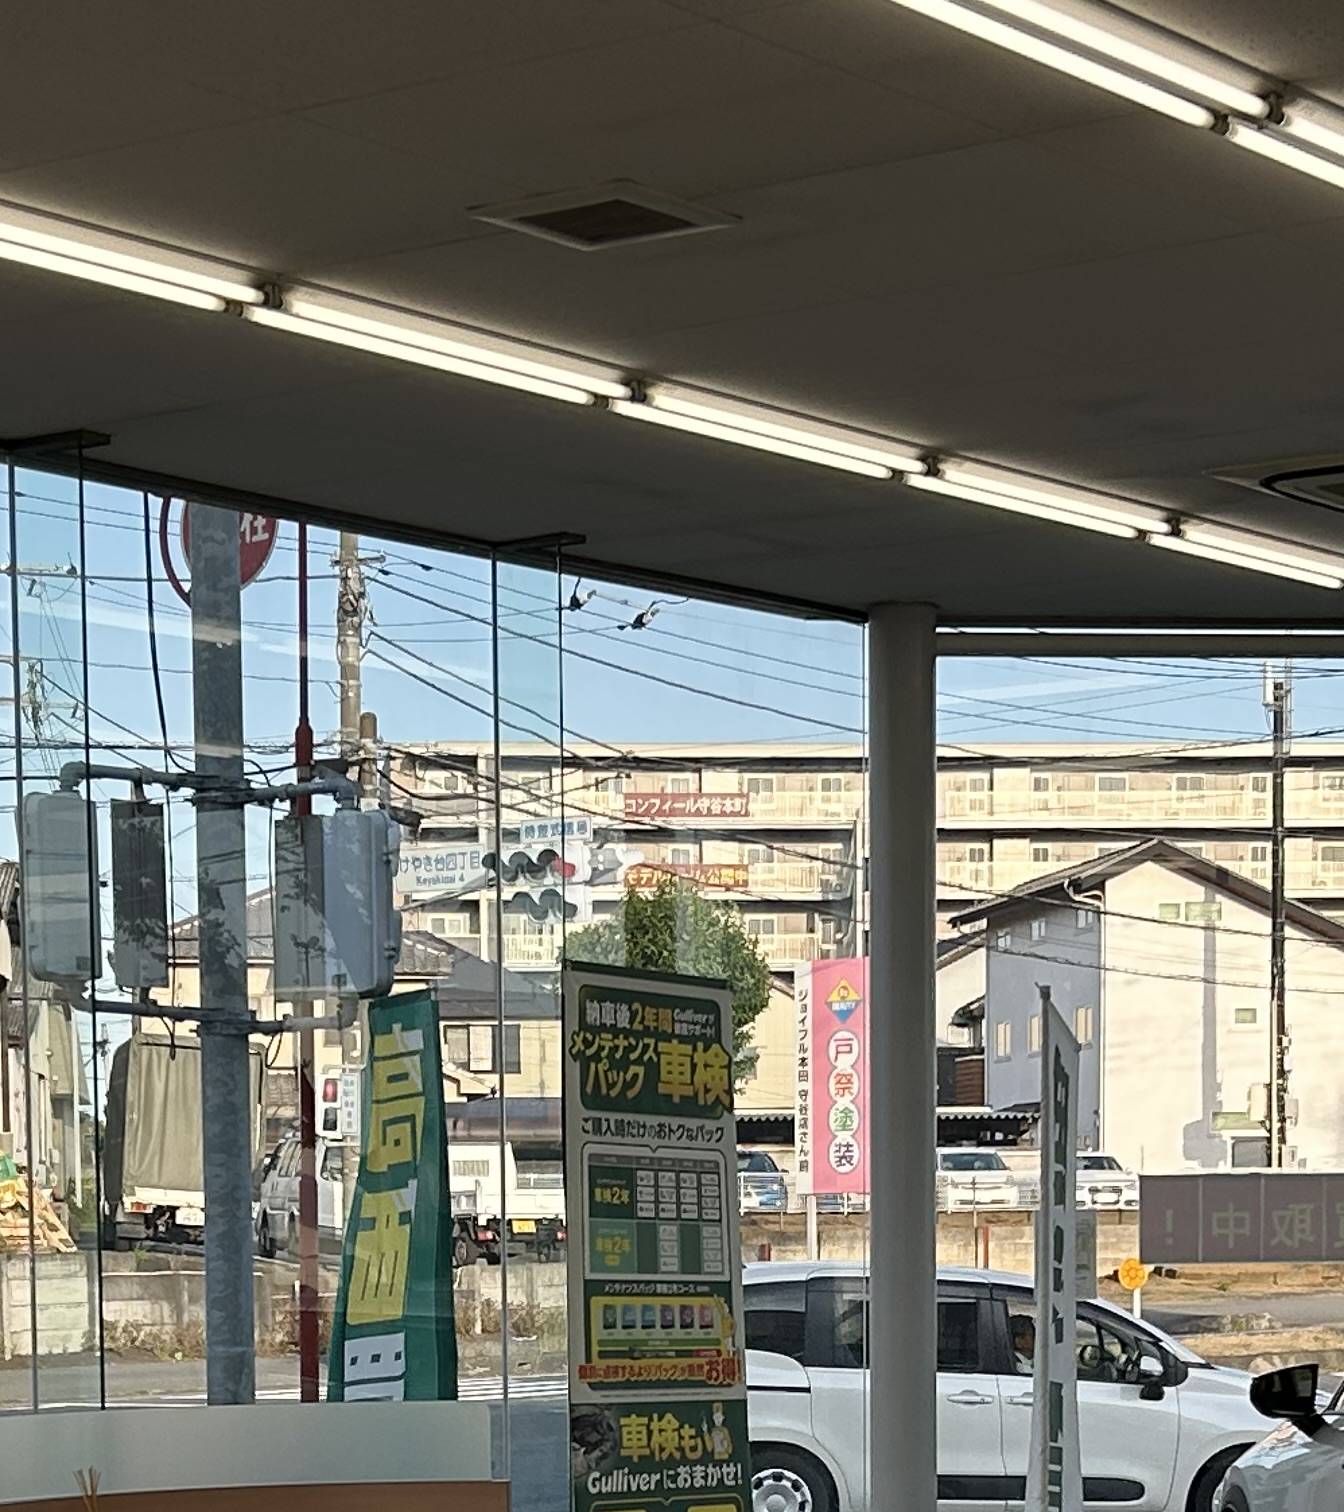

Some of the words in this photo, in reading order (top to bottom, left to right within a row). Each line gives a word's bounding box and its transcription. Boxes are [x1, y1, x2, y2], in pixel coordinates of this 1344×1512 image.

[399, 851, 480, 873] けやき台四丁目
[572, 1030, 657, 1063] メンテナンス
[586, 1058, 645, 1100] パック
[658, 1038, 730, 1107] 車検
[833, 1037, 855, 1168] 戸祭塗装
